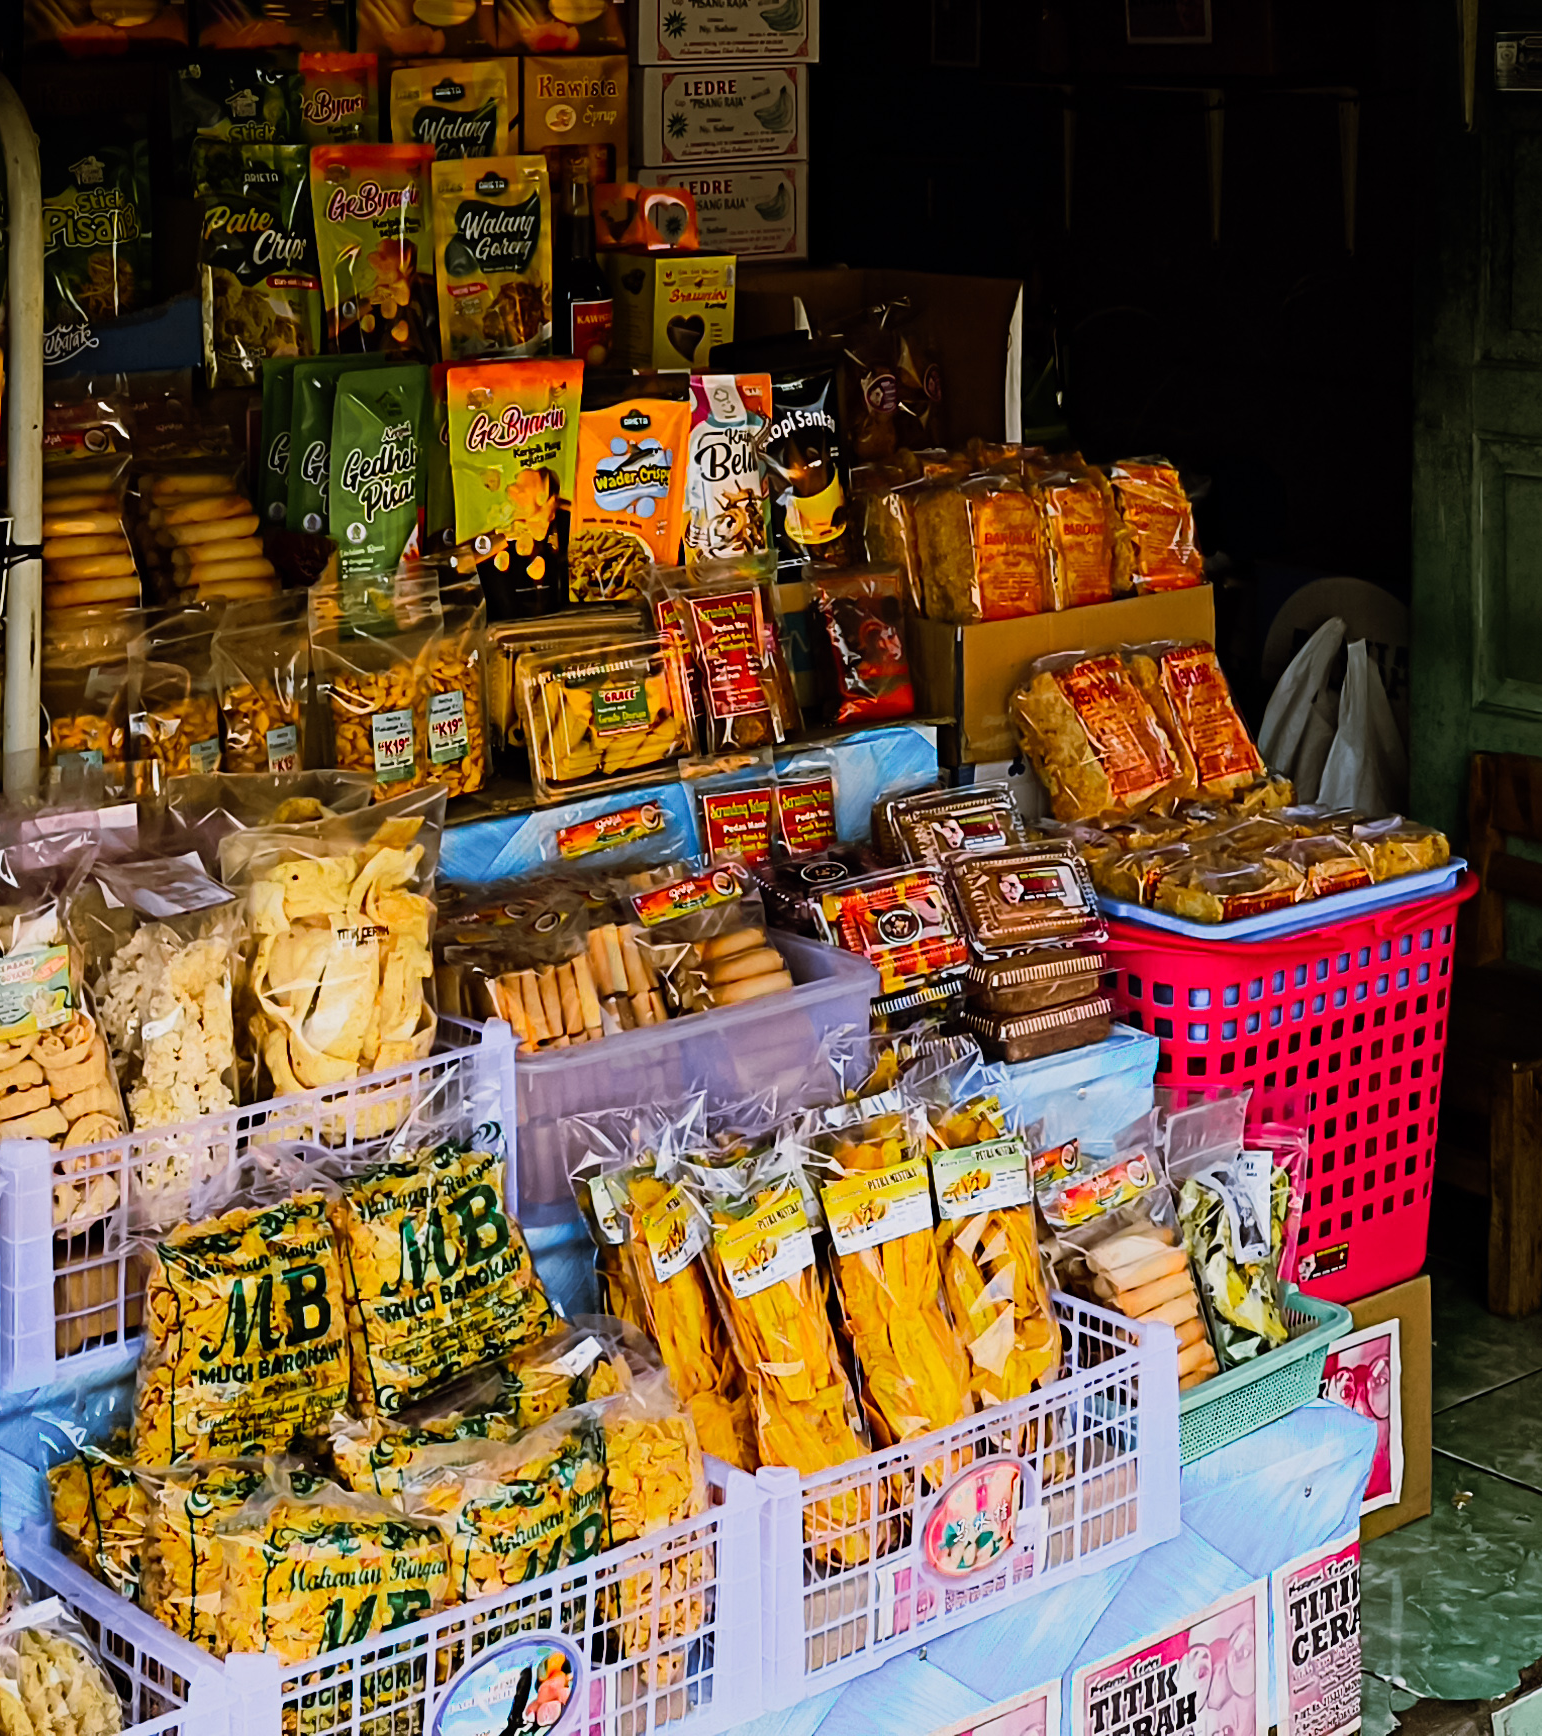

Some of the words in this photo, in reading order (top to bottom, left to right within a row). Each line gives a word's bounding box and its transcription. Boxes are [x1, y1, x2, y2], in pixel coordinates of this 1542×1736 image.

[537, 75, 618, 98] Kawista
[684, 79, 737, 97] LEDRE
[418, 115, 492, 144] Walang
[583, 105, 617, 125] Syrup
[75, 187, 126, 214] Stick
[43, 204, 139, 248] Pisang
[204, 206, 274, 240] Pare
[461, 210, 536, 240] Walang
[475, 234, 532, 261] Goreng
[595, 470, 637, 494] Wader
[380, 1183, 510, 1298] MB
[199, 1263, 332, 1363] MB
[1291, 1605, 1361, 1667] CERA
[1090, 1663, 1178, 1734] TITIK
